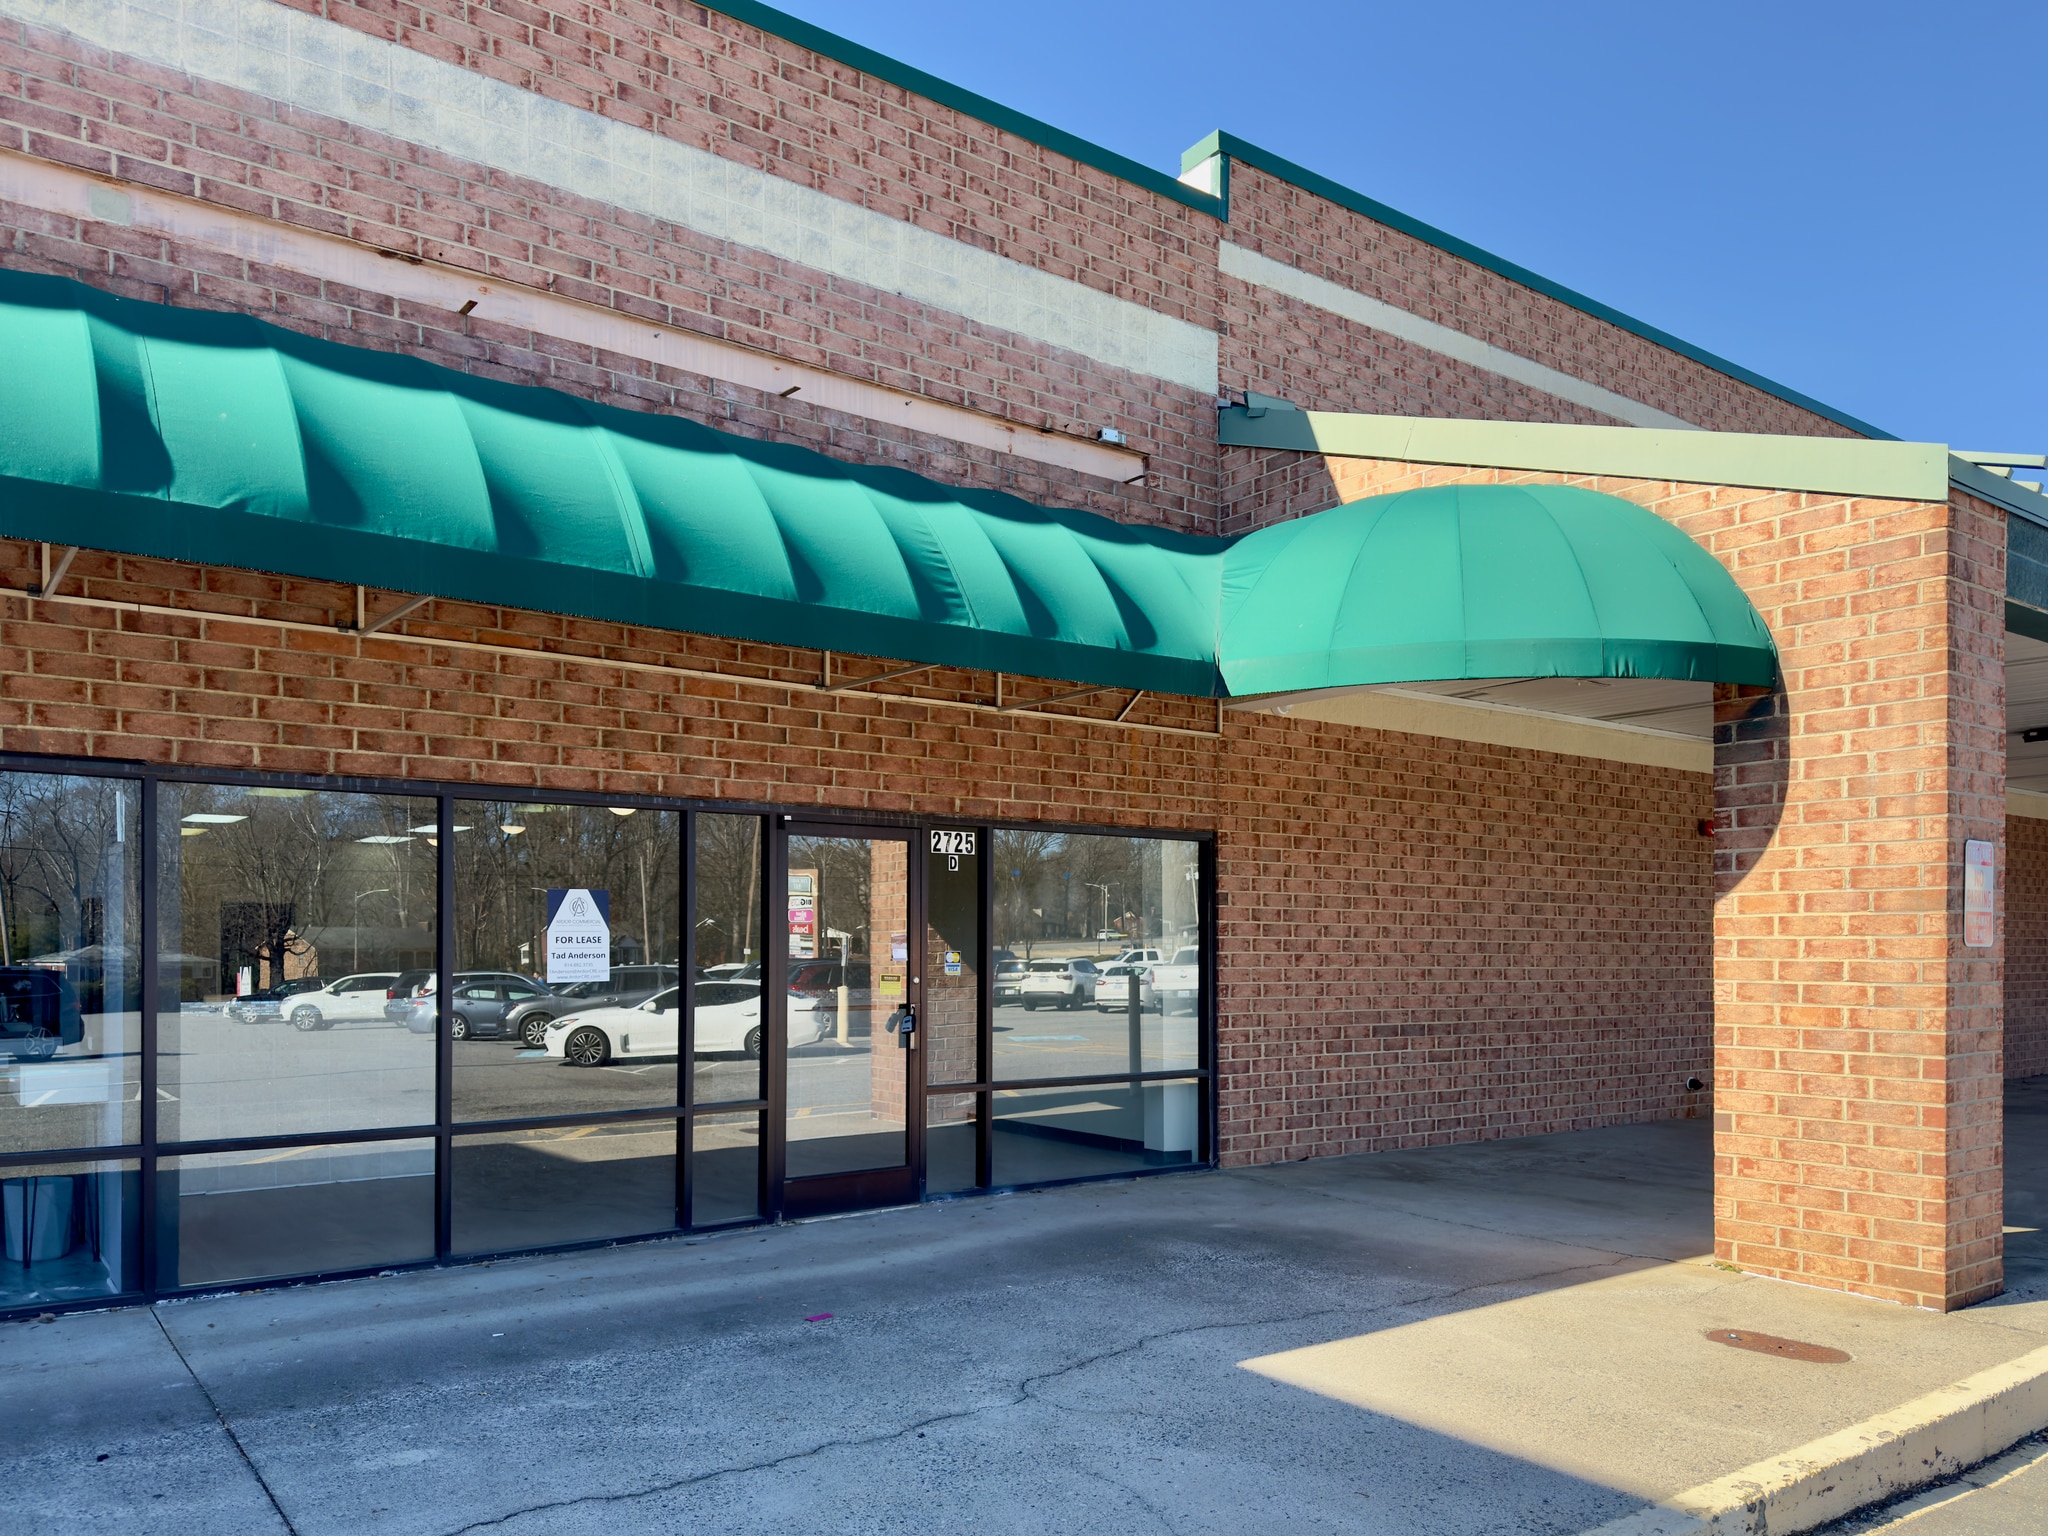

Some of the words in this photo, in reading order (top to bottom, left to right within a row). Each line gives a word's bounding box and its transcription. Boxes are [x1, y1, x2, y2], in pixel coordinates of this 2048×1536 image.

[932, 831, 974, 854] 2725
[950, 856, 957, 870] D
[1973, 869, 1985, 887] NO
[1966, 889, 1992, 909] PARKING
[555, 936, 573, 944] FOR
[576, 936, 602, 944] LEASE
[551, 952, 566, 960] Tad
[568, 952, 606, 960] Anderson
